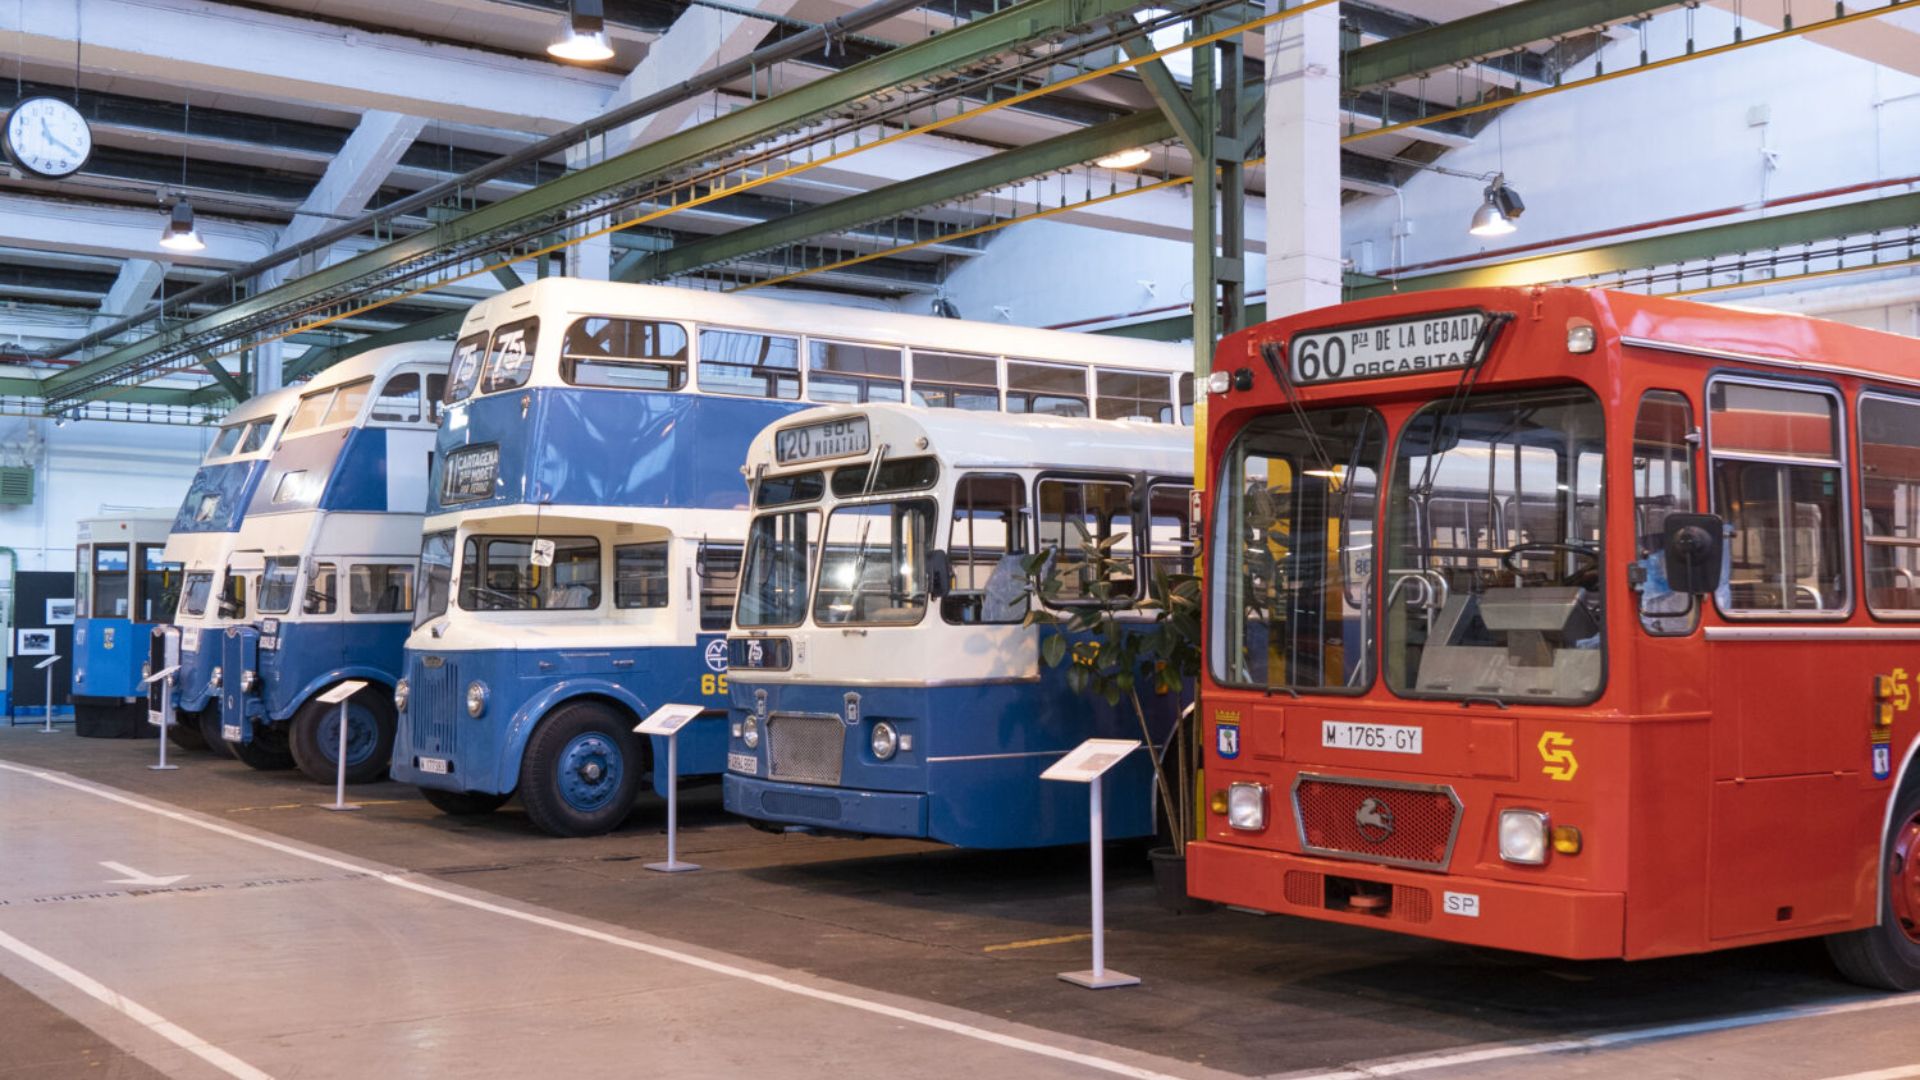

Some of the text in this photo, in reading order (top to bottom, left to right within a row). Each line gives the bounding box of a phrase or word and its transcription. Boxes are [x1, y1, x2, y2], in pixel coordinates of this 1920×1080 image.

[1376, 329, 1390, 351] DE
[1399, 326, 1416, 349] LA
[1424, 316, 1480, 346] CEBADA
[493, 329, 526, 372] 75
[1299, 336, 1347, 381] 60
[1353, 349, 1476, 376] ORCASITAS
[823, 422, 854, 437] SOL
[747, 639, 763, 662] 75
[1448, 896, 1474, 912] SP
